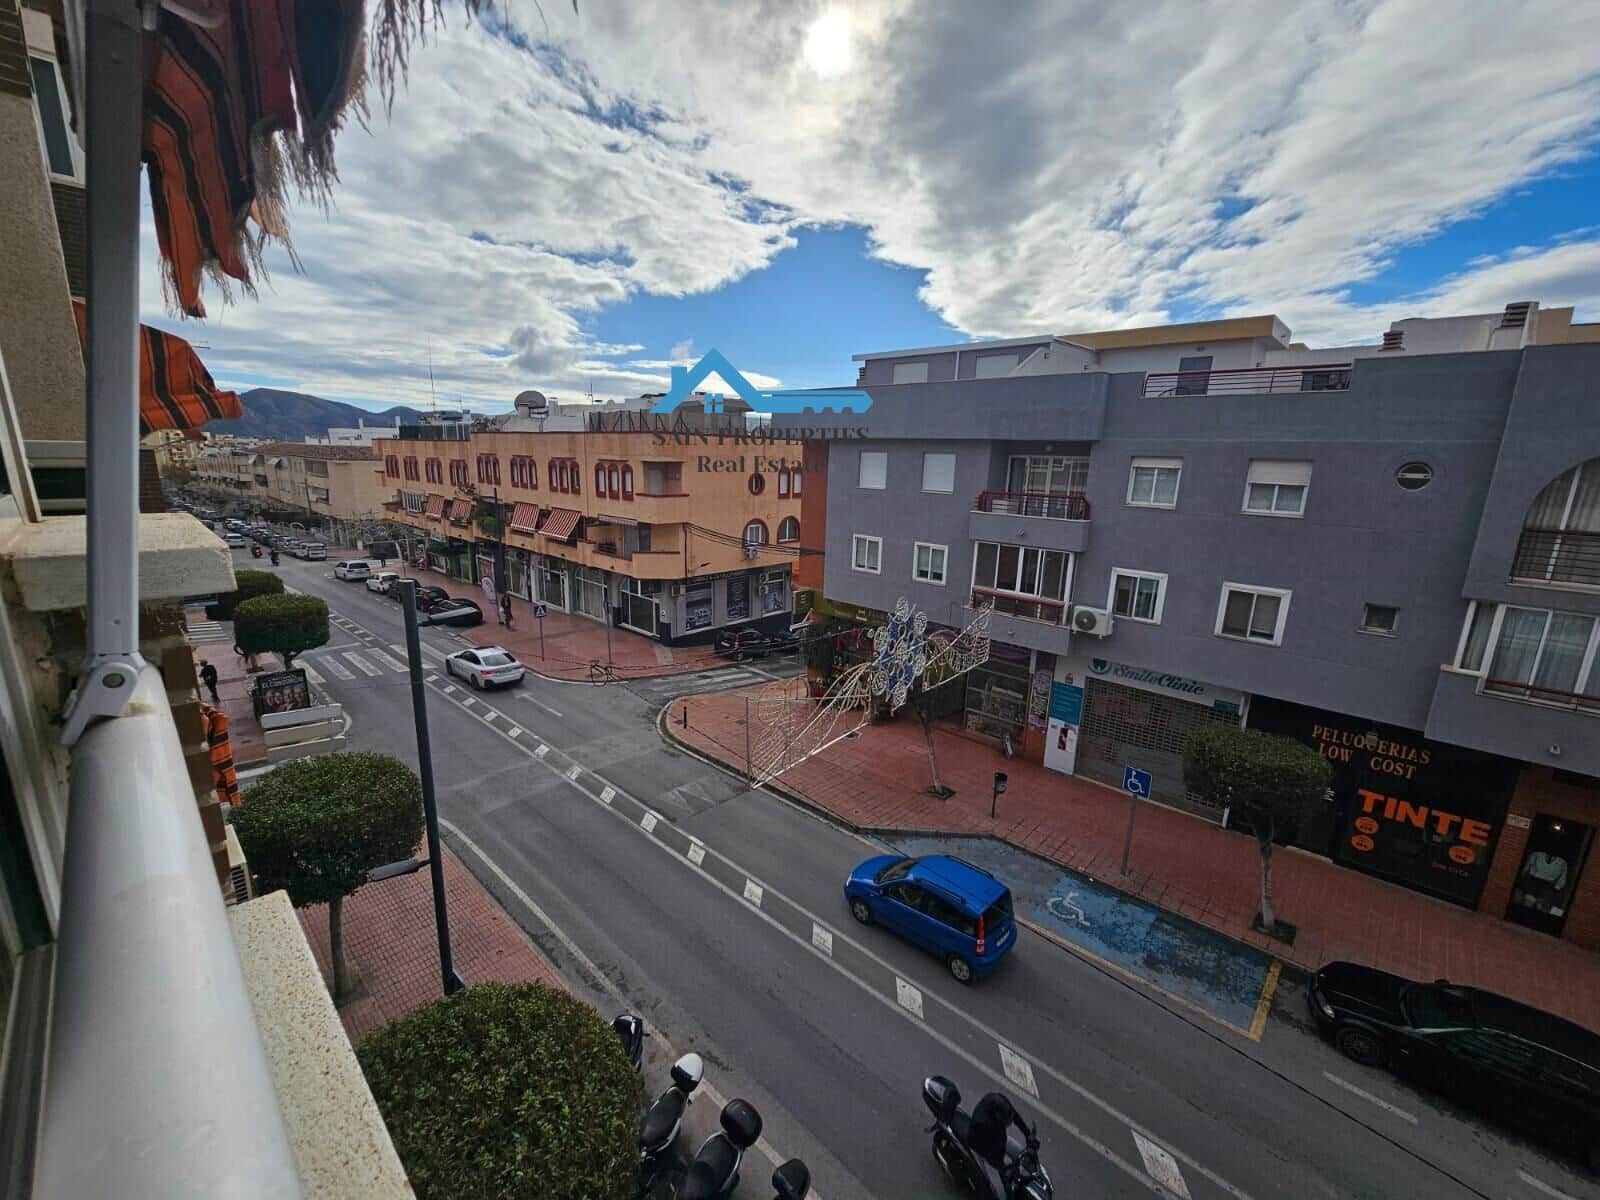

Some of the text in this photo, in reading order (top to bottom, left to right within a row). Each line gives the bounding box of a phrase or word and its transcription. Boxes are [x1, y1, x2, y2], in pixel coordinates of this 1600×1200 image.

[1319, 742, 1417, 780] LOW COST
[1358, 789, 1493, 847] TINTE
